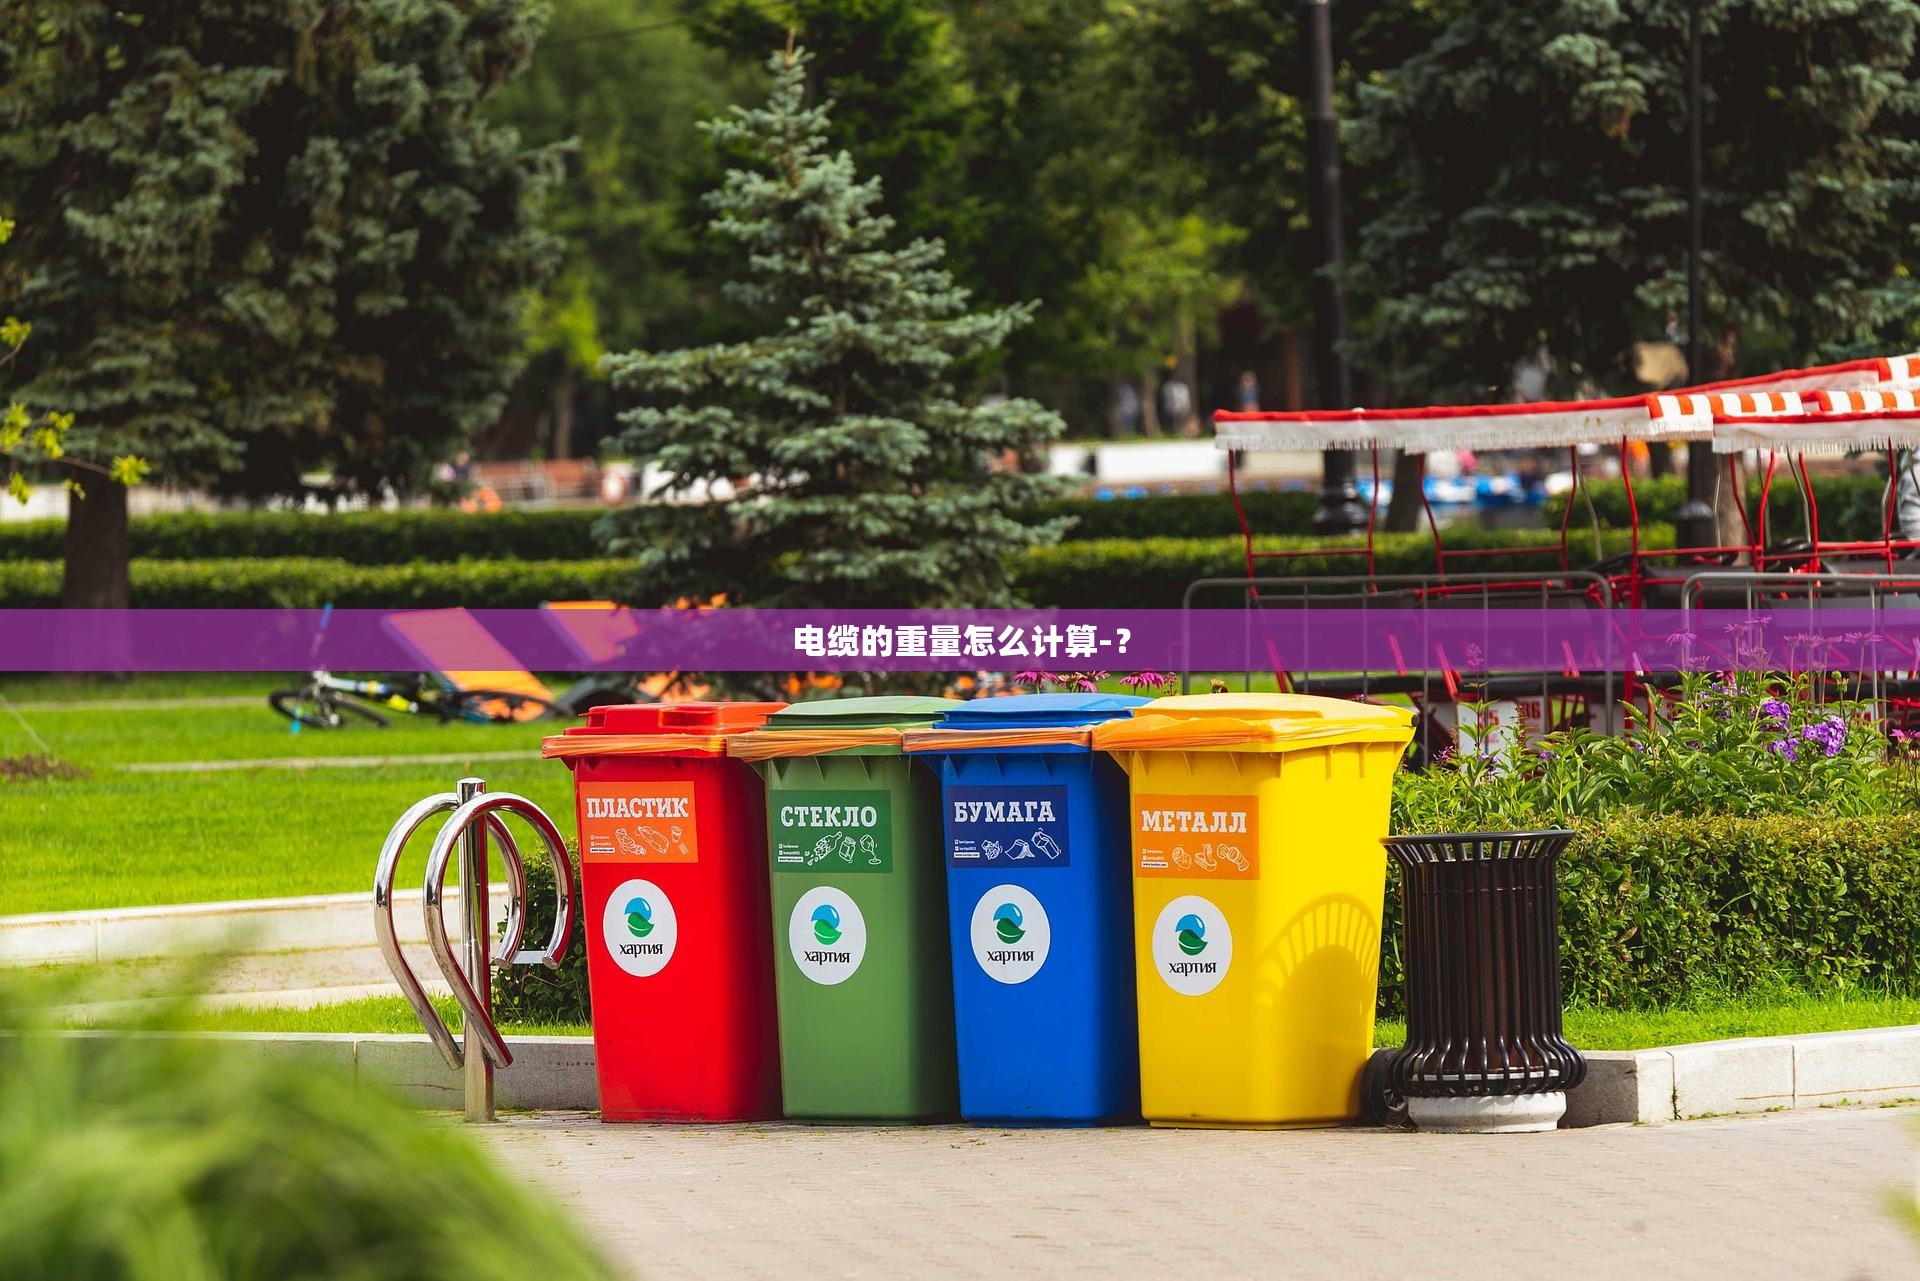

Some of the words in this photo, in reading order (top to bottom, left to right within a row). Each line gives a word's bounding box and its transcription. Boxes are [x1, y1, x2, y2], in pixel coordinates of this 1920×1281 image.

[586, 797, 689, 818] ПЛАСТИК
[780, 806, 877, 827] СТЕКЛО
[954, 801, 1056, 823] БУМАГА
[1141, 810, 1247, 833] МЕТАЛЛ
[618, 943, 664, 959] хартия
[804, 950, 851, 966] хартия
[986, 949, 1035, 966] хартия
[1168, 960, 1217, 977] хартия
